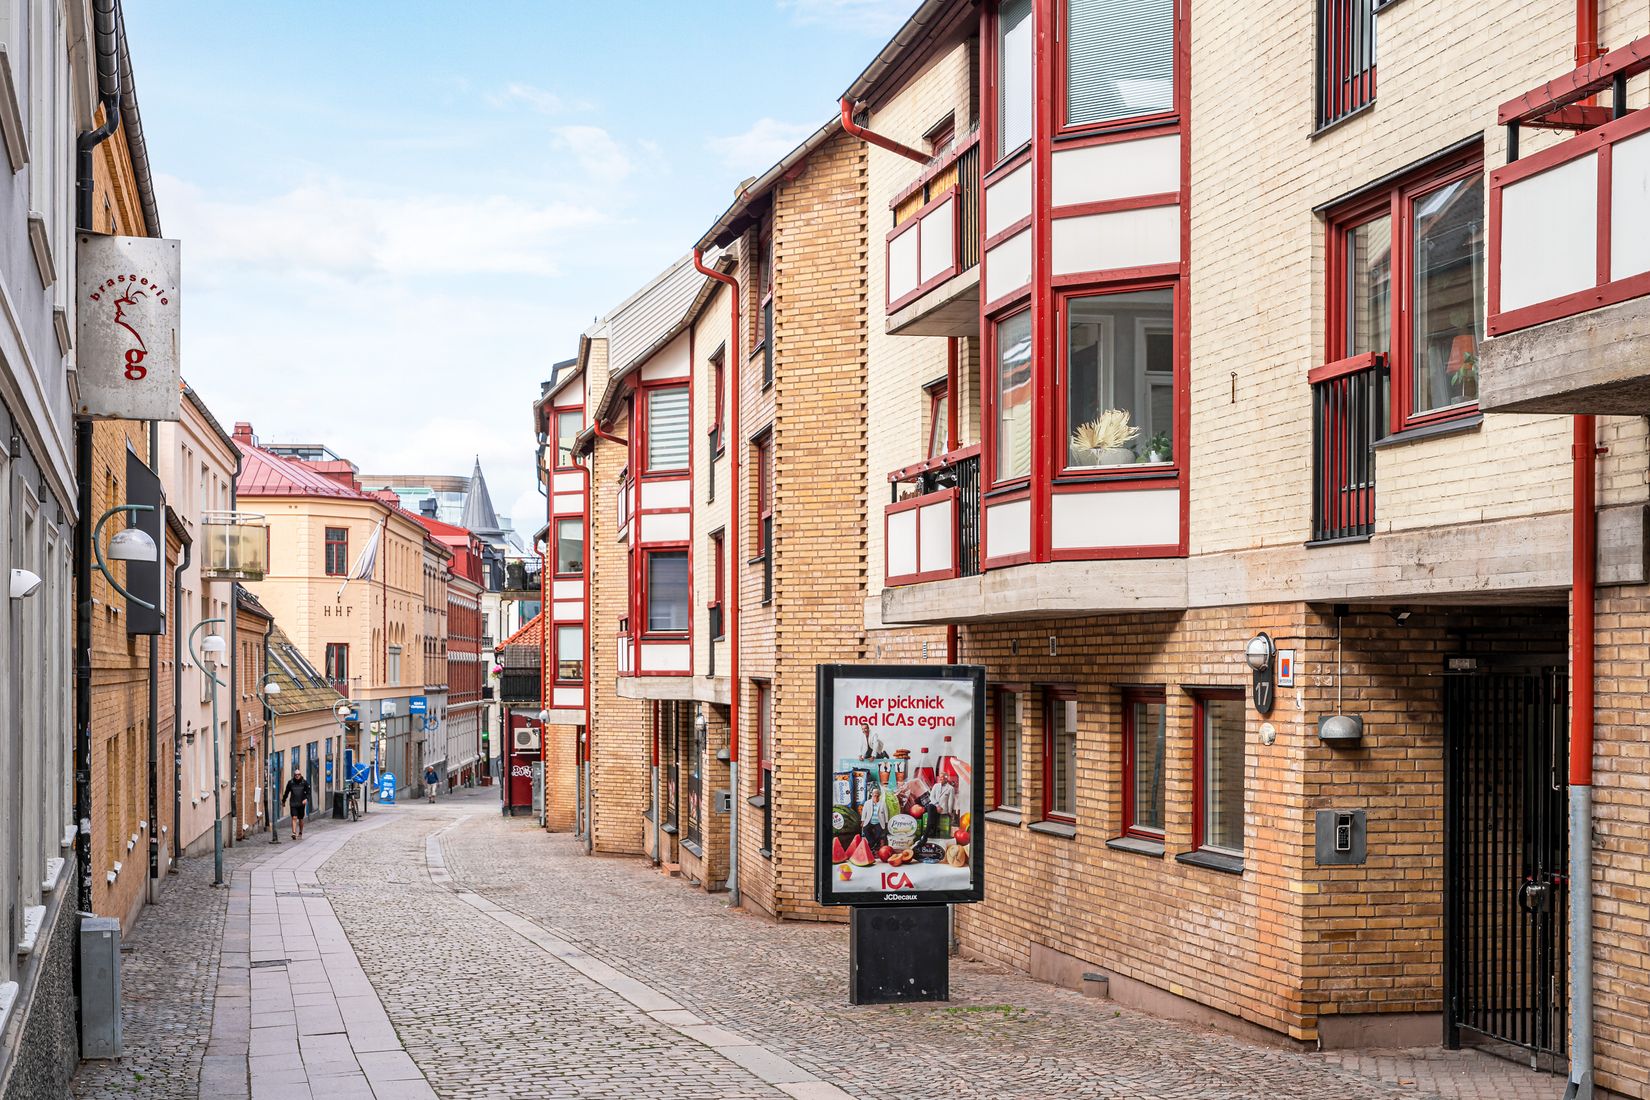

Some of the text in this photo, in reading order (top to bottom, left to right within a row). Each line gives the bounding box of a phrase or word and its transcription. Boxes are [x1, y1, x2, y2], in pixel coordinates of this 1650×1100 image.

[90, 274, 168, 305] brasserie
[1255, 681, 1270, 706] 17
[855, 695, 945, 712] Mer picknick
[844, 712, 956, 729] med ICAs egna
[881, 871, 915, 890] ICA
[883, 893, 918, 901] JCDecaux
